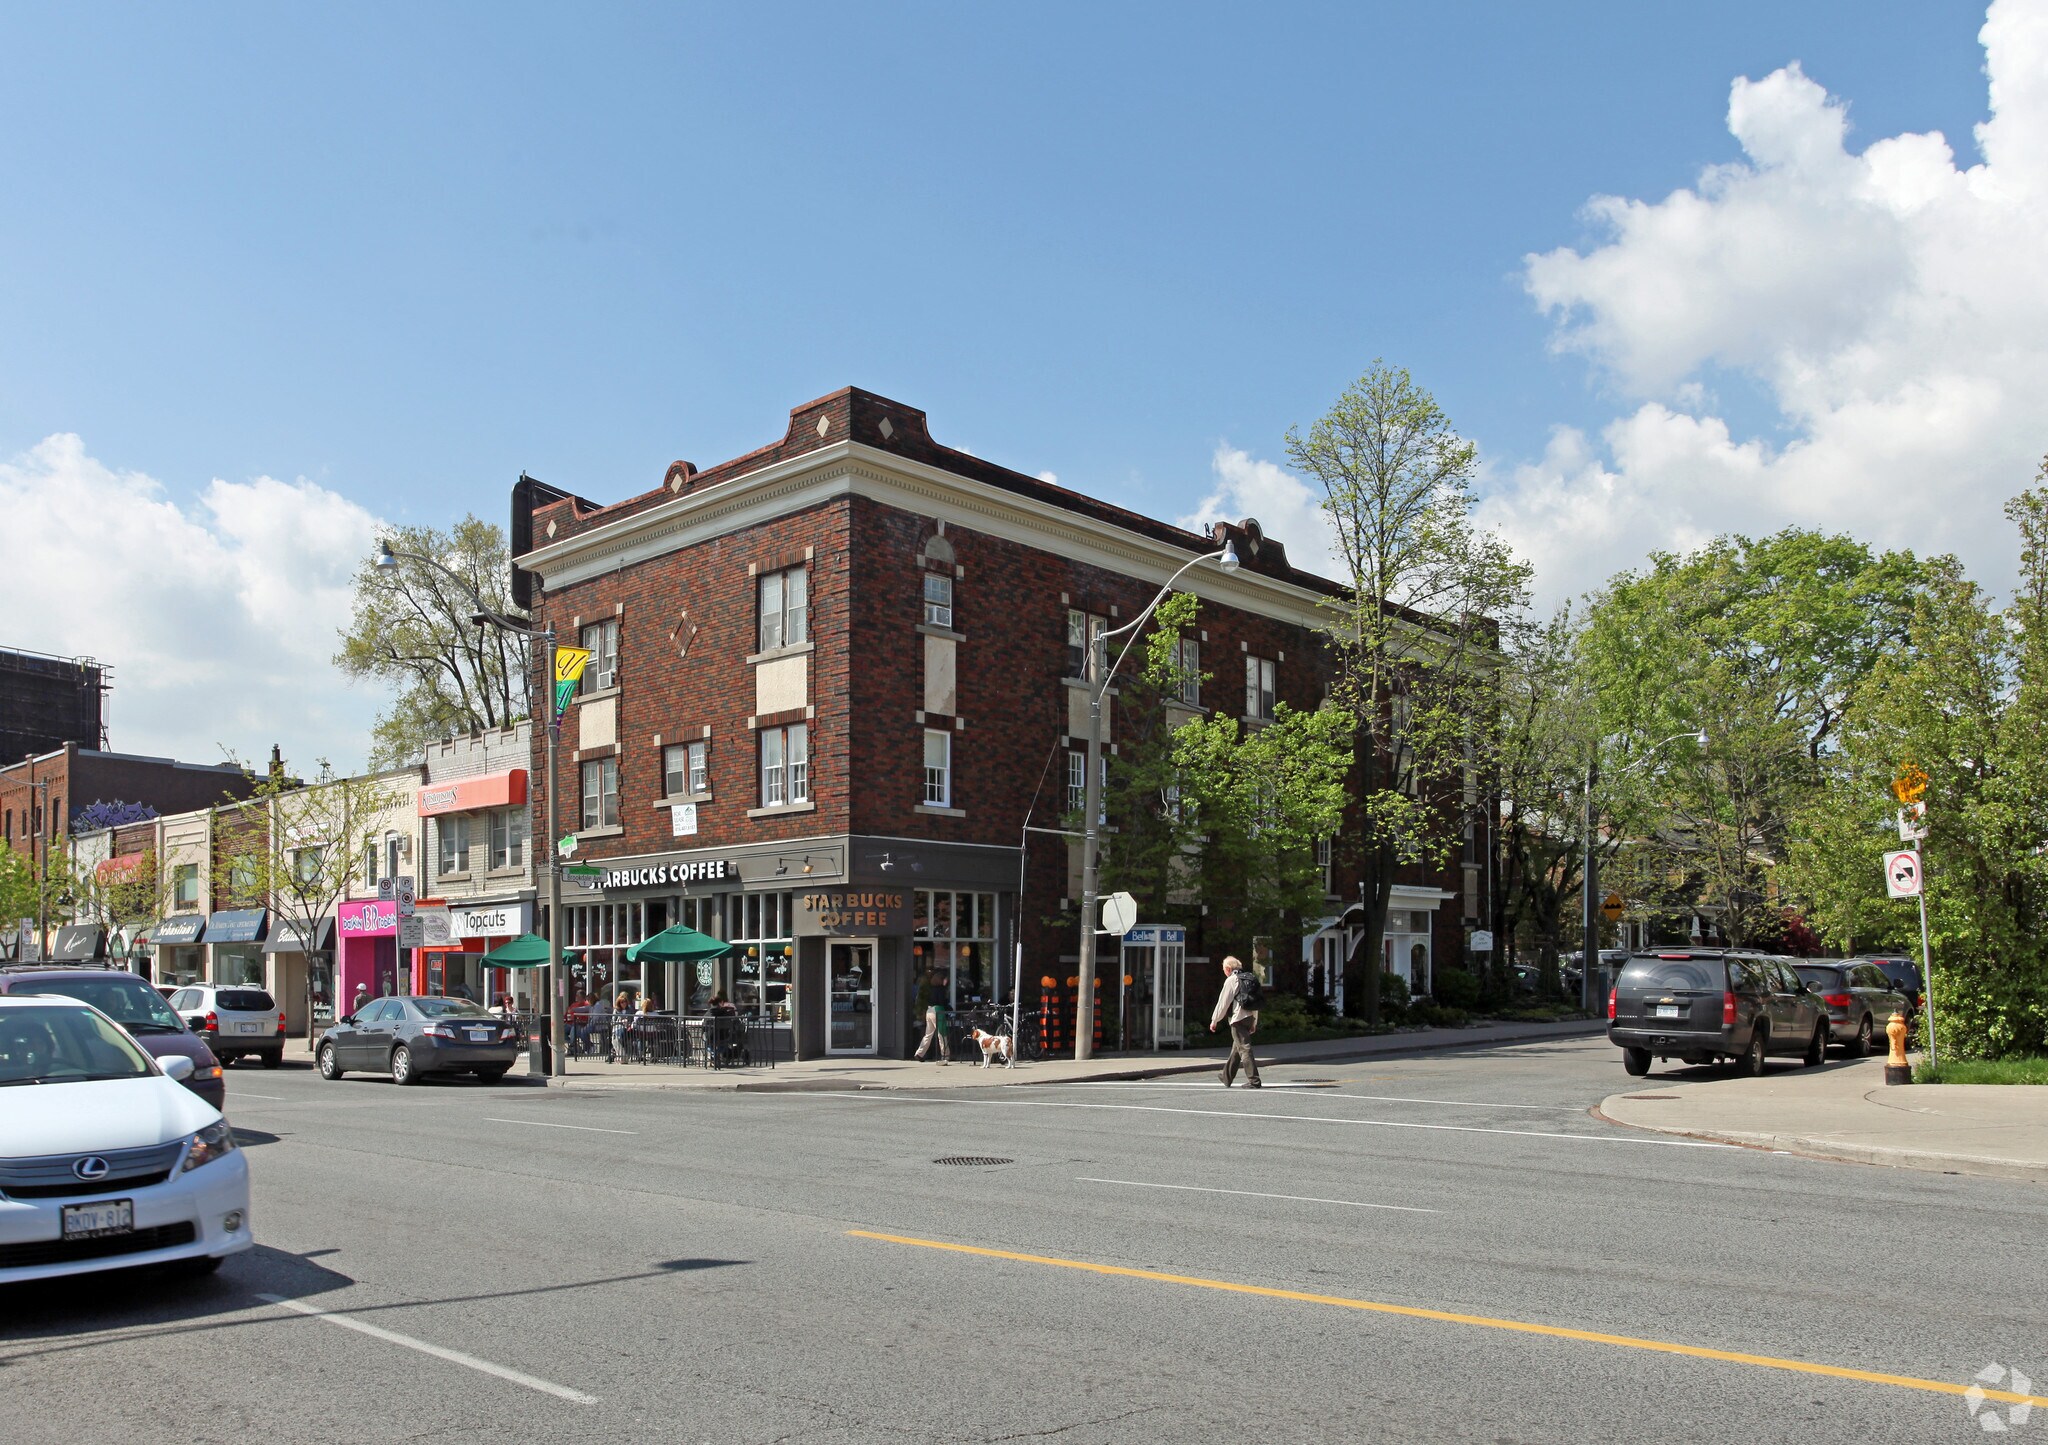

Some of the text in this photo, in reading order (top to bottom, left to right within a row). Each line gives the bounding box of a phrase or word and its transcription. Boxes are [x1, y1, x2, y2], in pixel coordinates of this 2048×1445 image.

[670, 861, 725, 882] COFFEE
[803, 893, 902, 909] STARBUCKS
[464, 909, 506, 932] Topcuts
[818, 911, 887, 927] COFFEE
[1132, 930, 1145, 941] Bell
[1166, 930, 1177, 941] Bell
